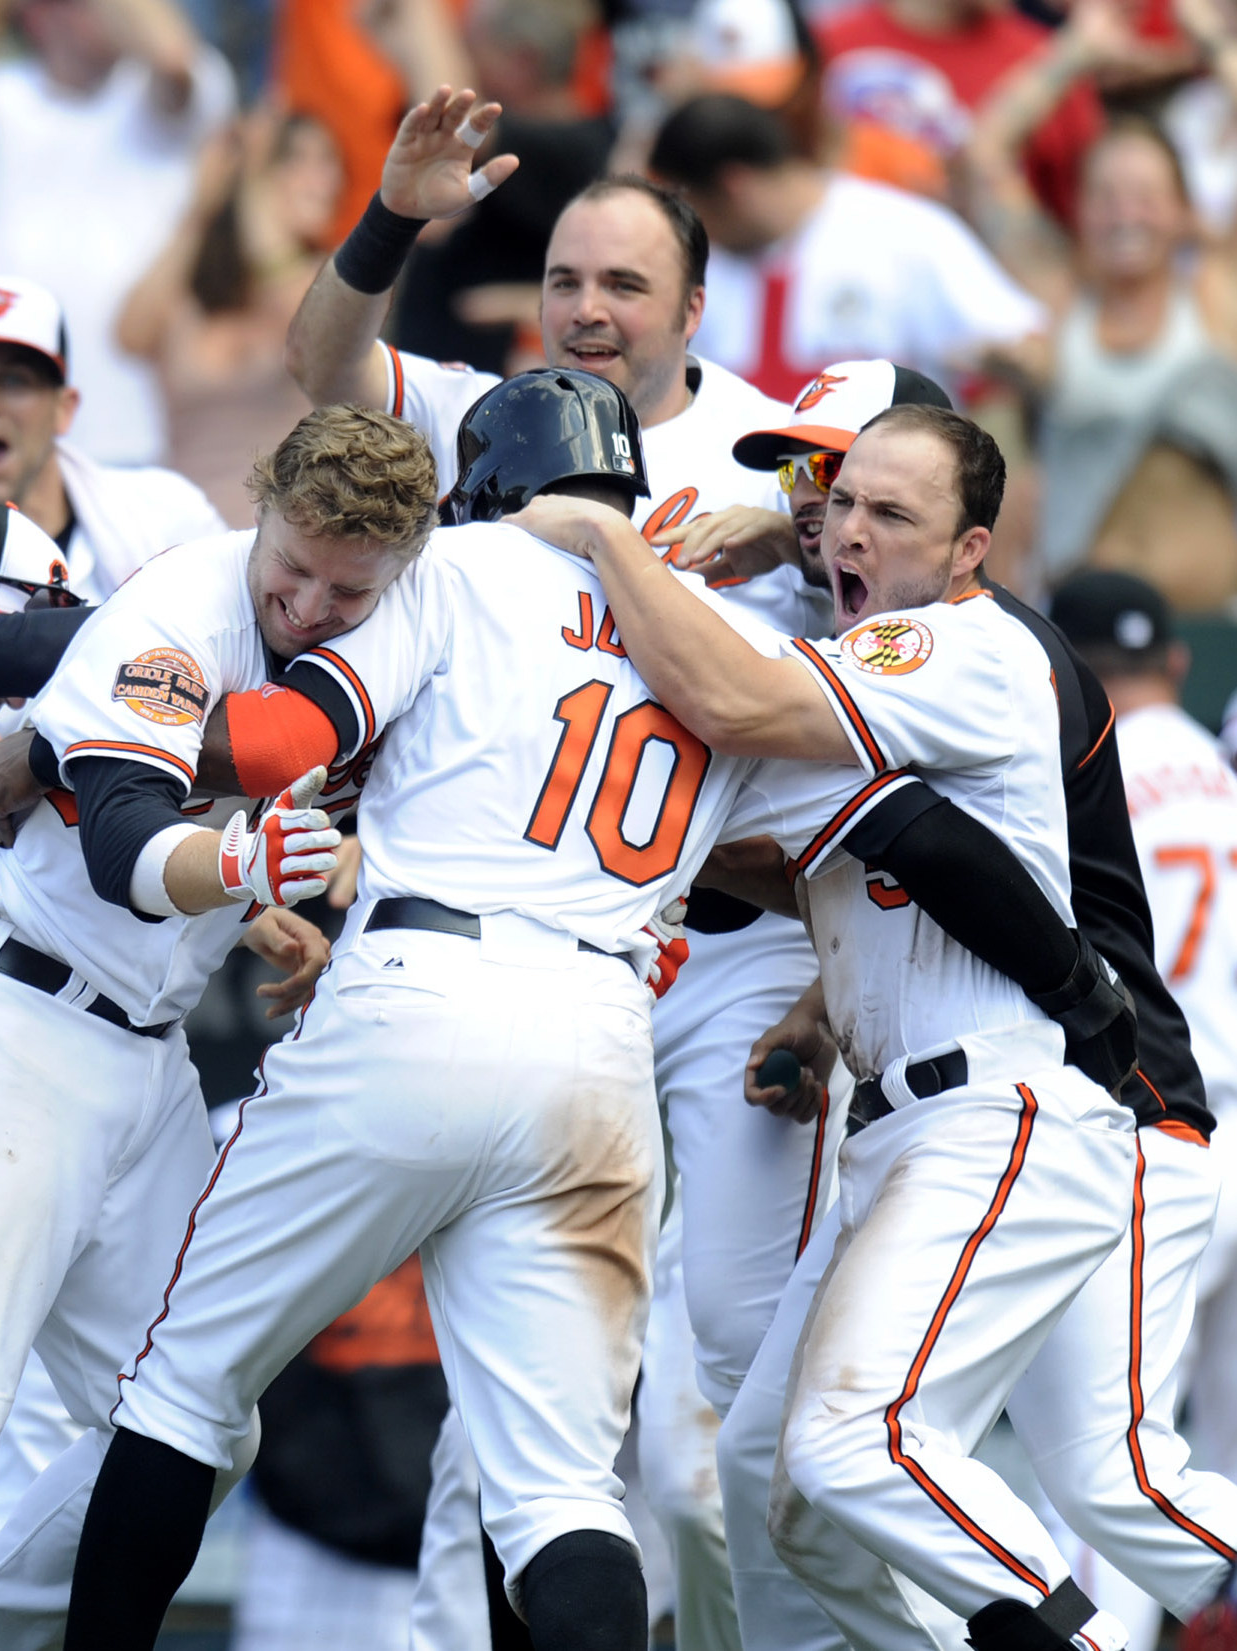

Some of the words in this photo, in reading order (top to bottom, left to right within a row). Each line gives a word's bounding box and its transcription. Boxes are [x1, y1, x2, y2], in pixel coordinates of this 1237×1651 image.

[612, 432, 631, 458] 10
[124, 665, 173, 684] ORIOLE
[175, 676, 205, 700] PARK
[115, 683, 170, 702] CAMDEN
[170, 692, 204, 720] YARDS
[523, 678, 713, 889] 10
